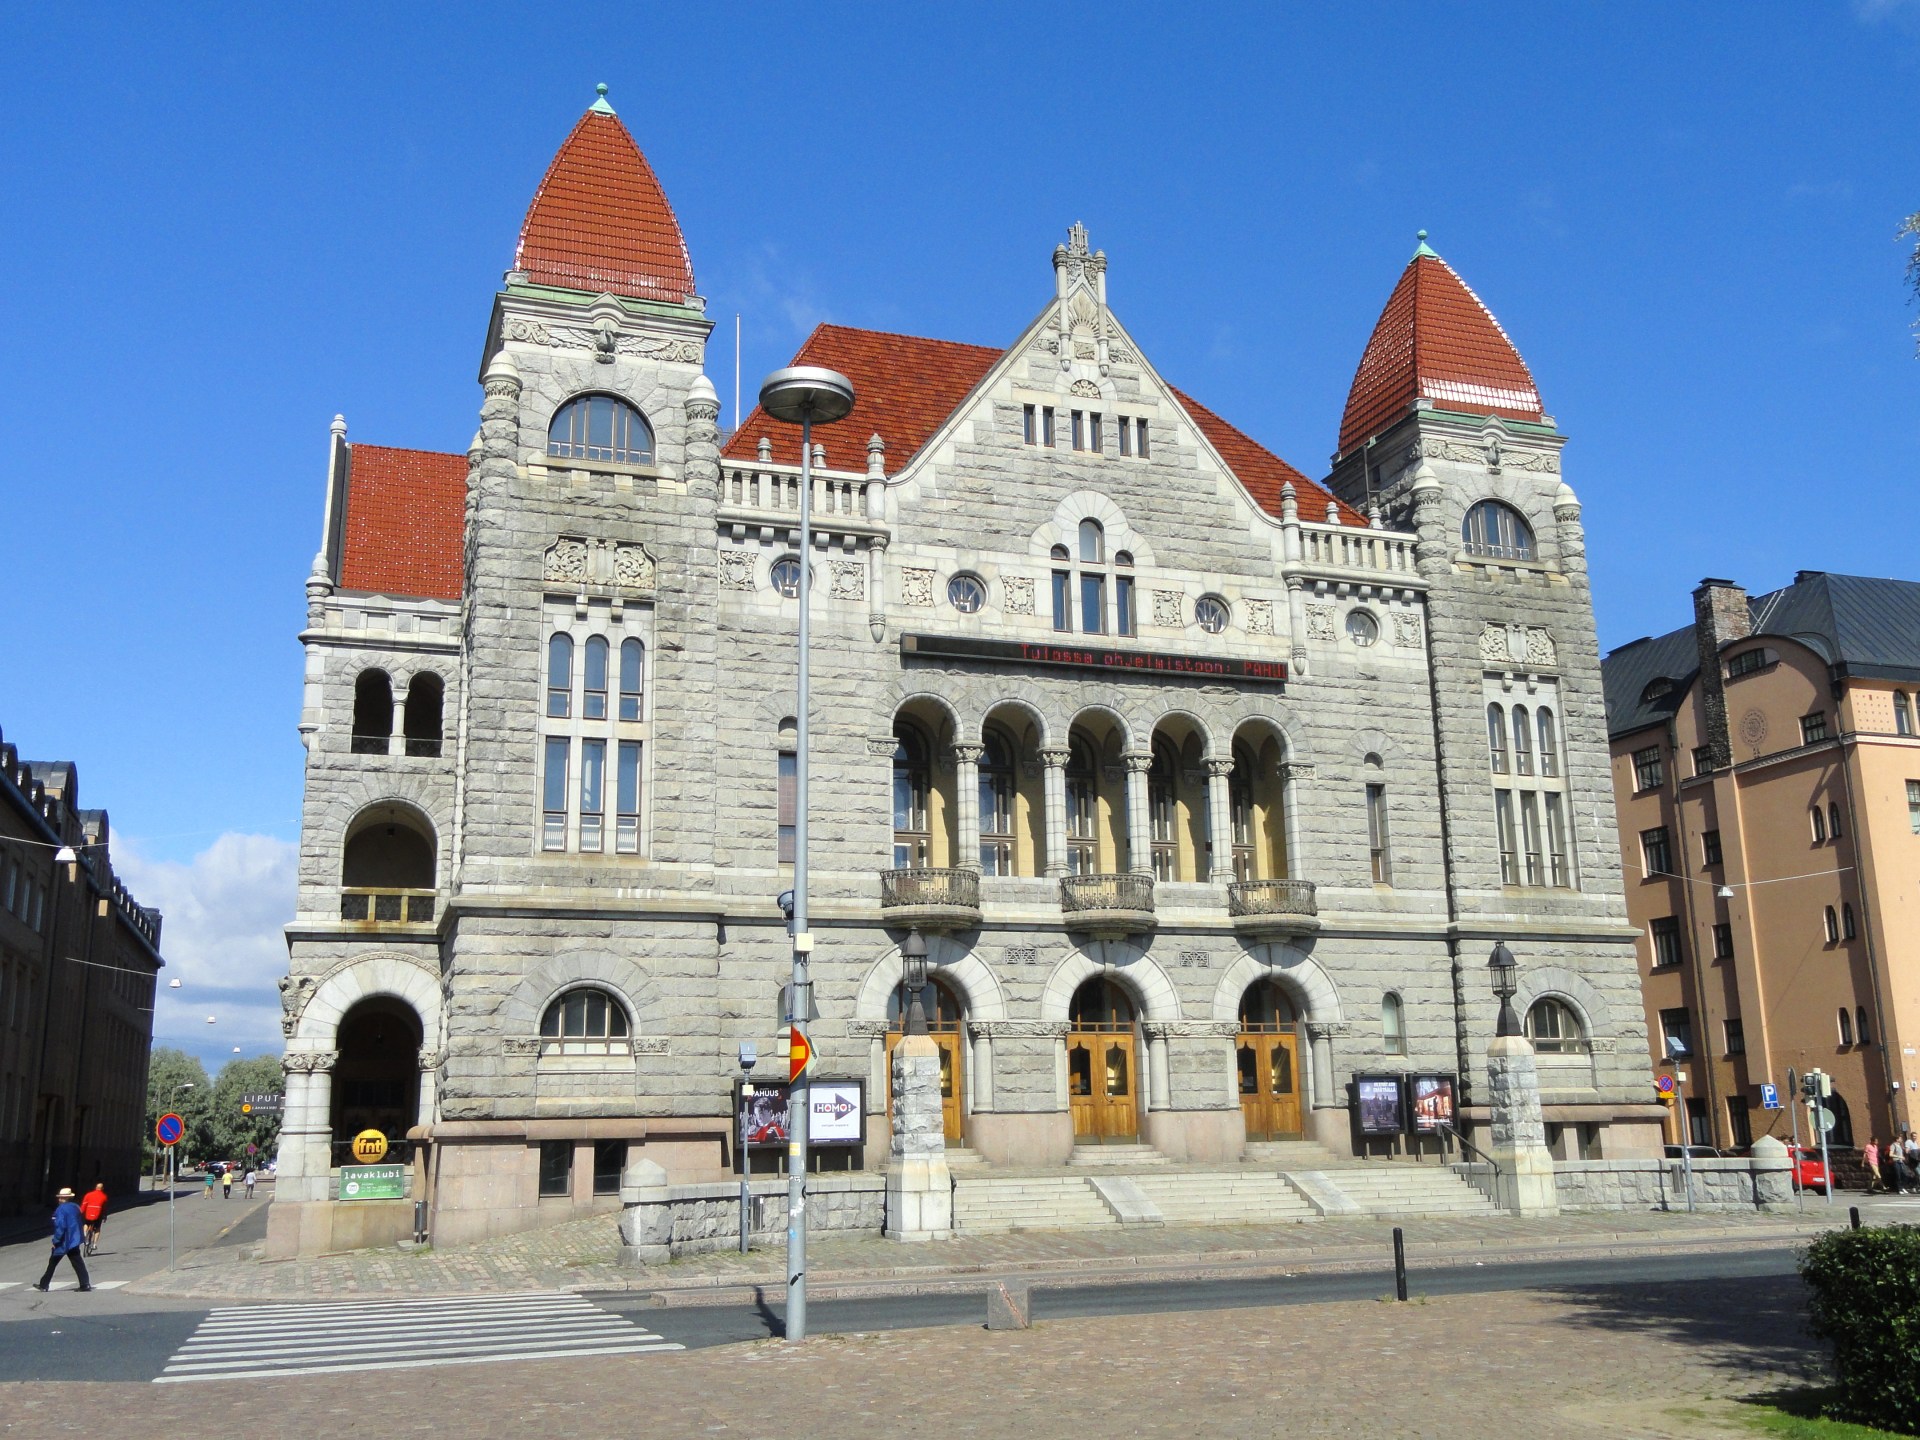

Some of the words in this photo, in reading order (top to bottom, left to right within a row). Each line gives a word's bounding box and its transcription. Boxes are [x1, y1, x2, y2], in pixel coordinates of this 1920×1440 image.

[1020, 643, 1093, 664] Tulossa
[244, 1094, 279, 1103] LIPUT
[1765, 1086, 1774, 1101] P
[816, 1103, 852, 1113] HOMO!
[359, 1139, 381, 1153] fnt
[344, 1169, 400, 1180] lavaklubi
